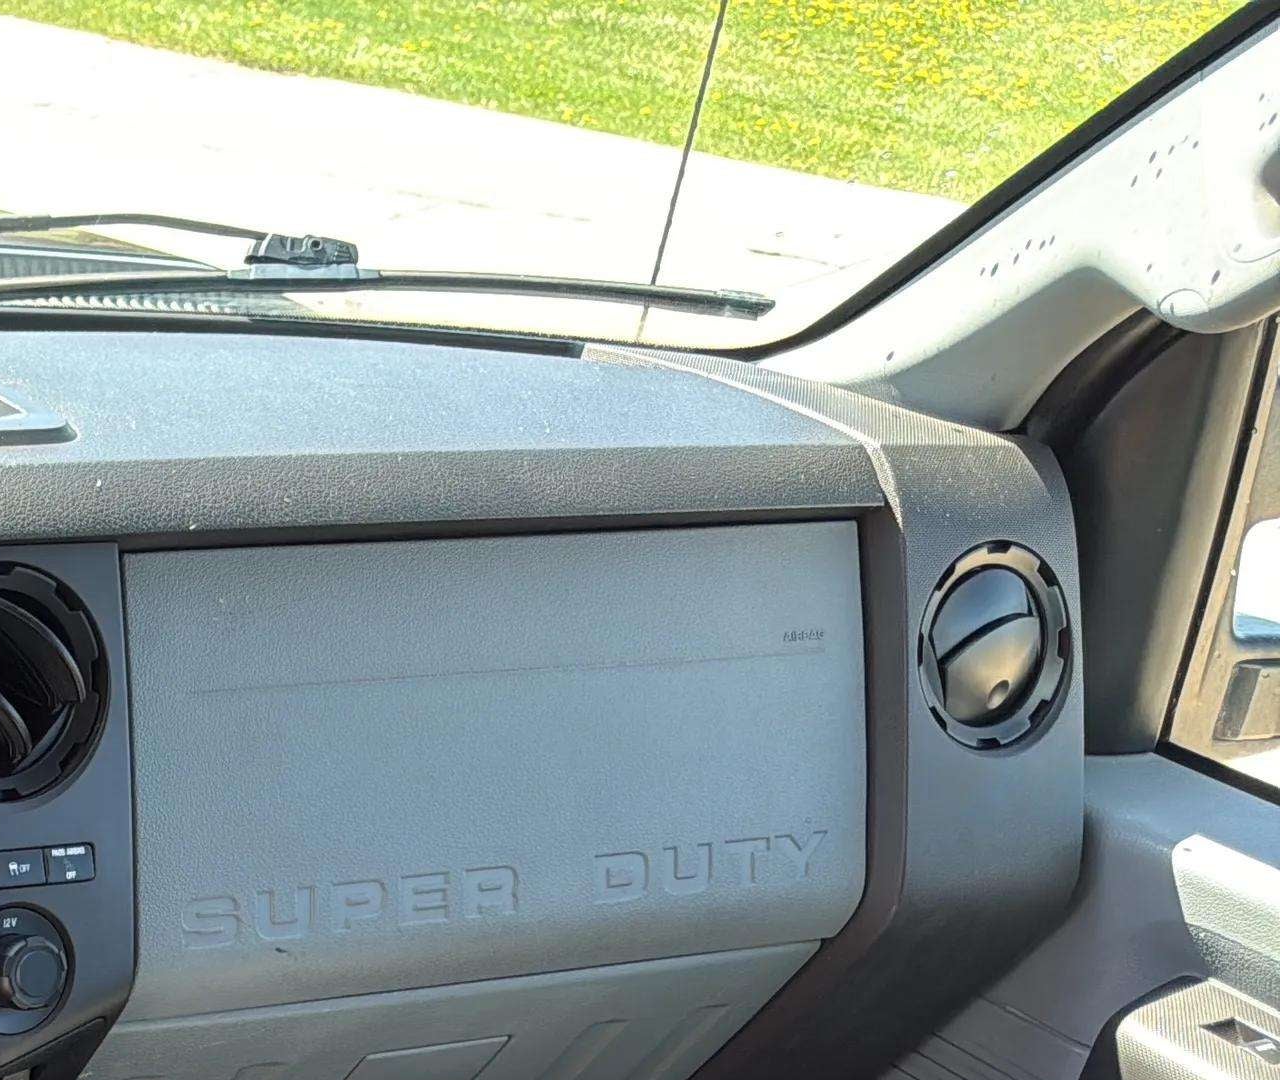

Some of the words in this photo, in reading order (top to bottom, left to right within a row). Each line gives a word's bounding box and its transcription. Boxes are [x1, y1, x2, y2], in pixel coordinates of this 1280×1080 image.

[19, 864, 30, 873] OFF
[182, 865, 519, 949] SUPER
[594, 831, 827, 902] DUTY
